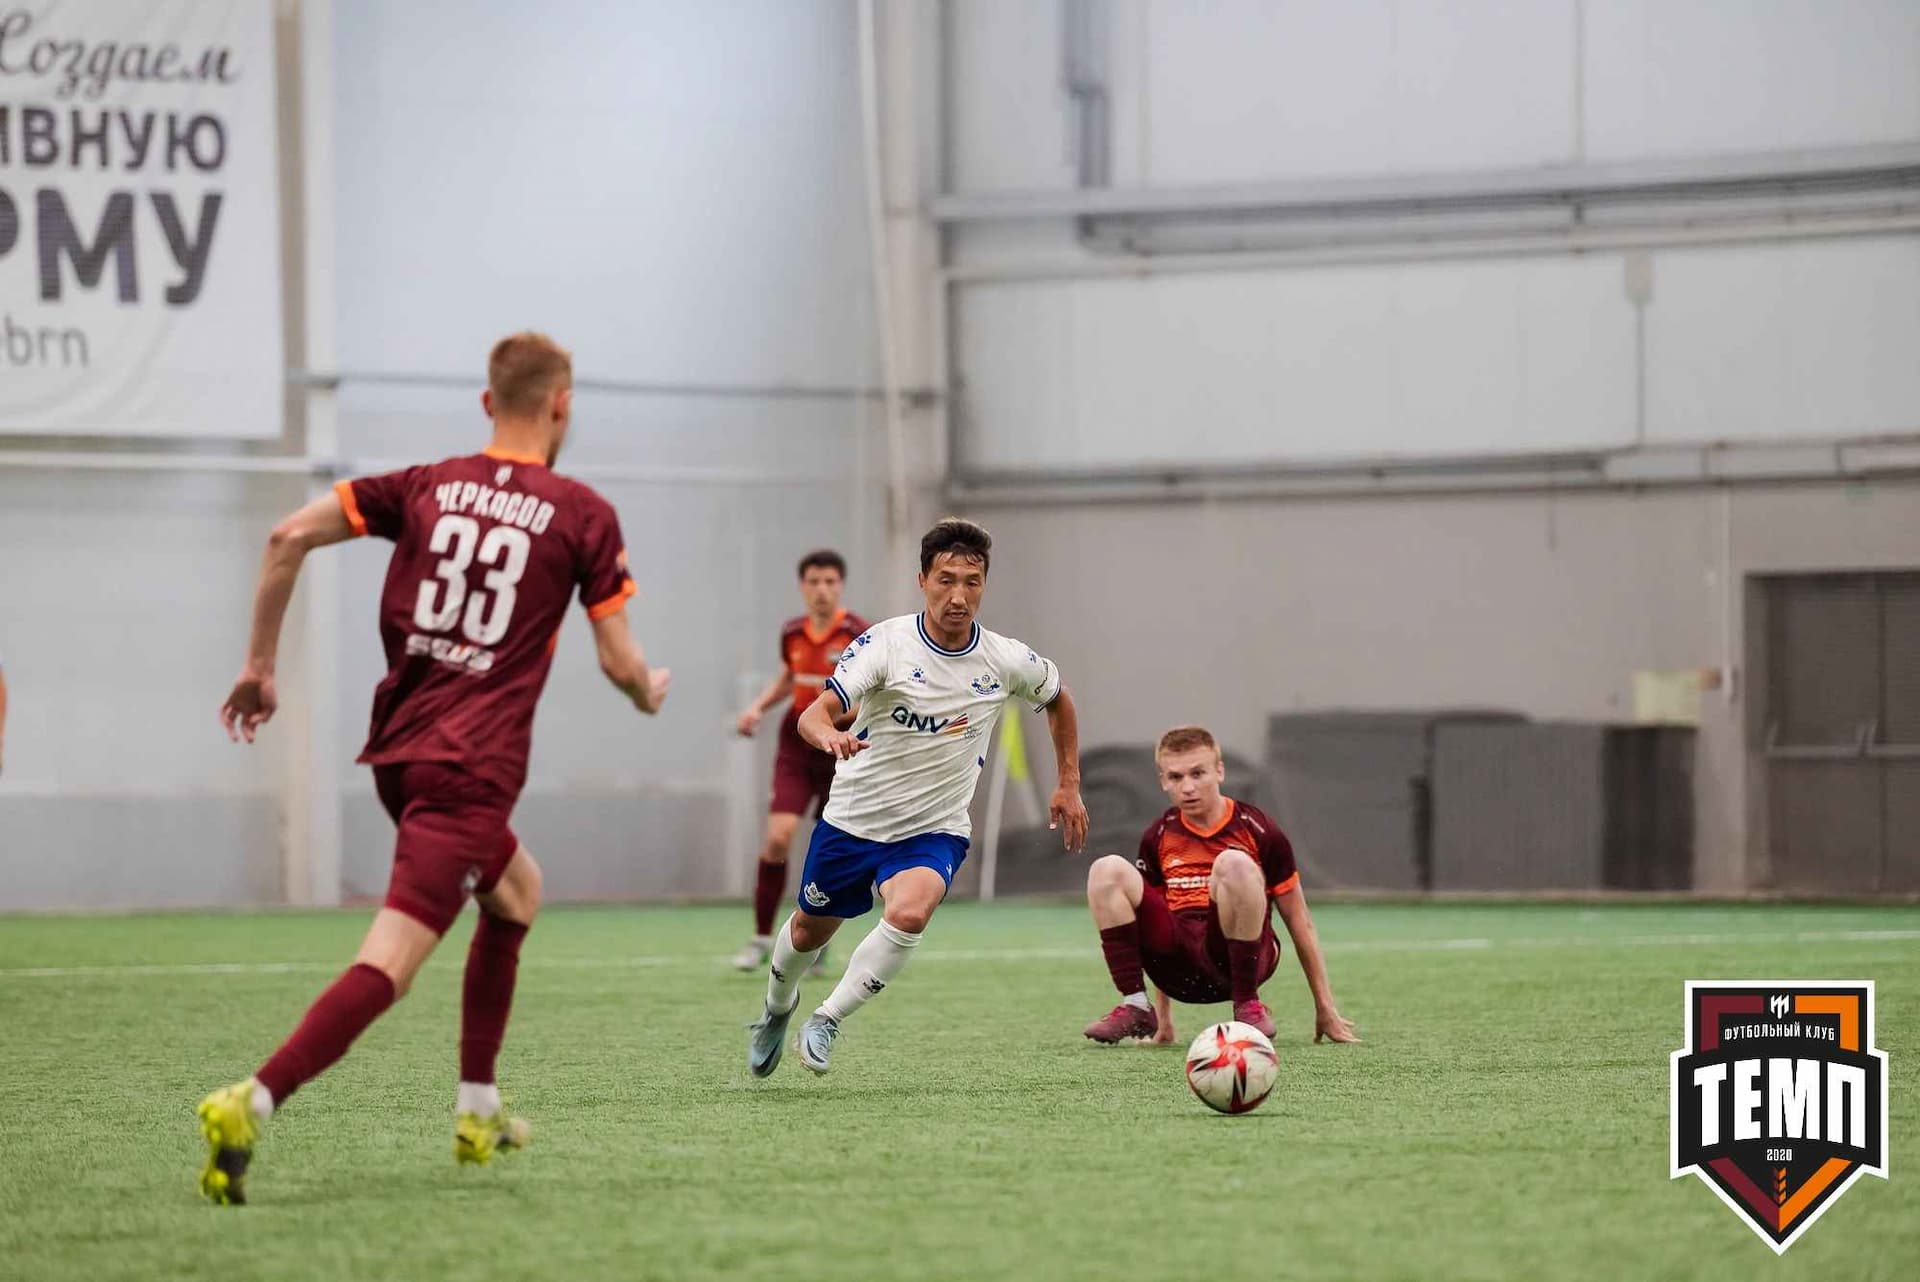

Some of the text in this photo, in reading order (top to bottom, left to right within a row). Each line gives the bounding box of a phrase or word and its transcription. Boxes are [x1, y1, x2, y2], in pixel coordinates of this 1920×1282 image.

[0, 9, 237, 99] Создаем
[0, 186, 223, 306] МУ
[0, 312, 89, 368] brn
[435, 480, 556, 535] ЧЕРКАСОВ
[413, 514, 532, 646] 33
